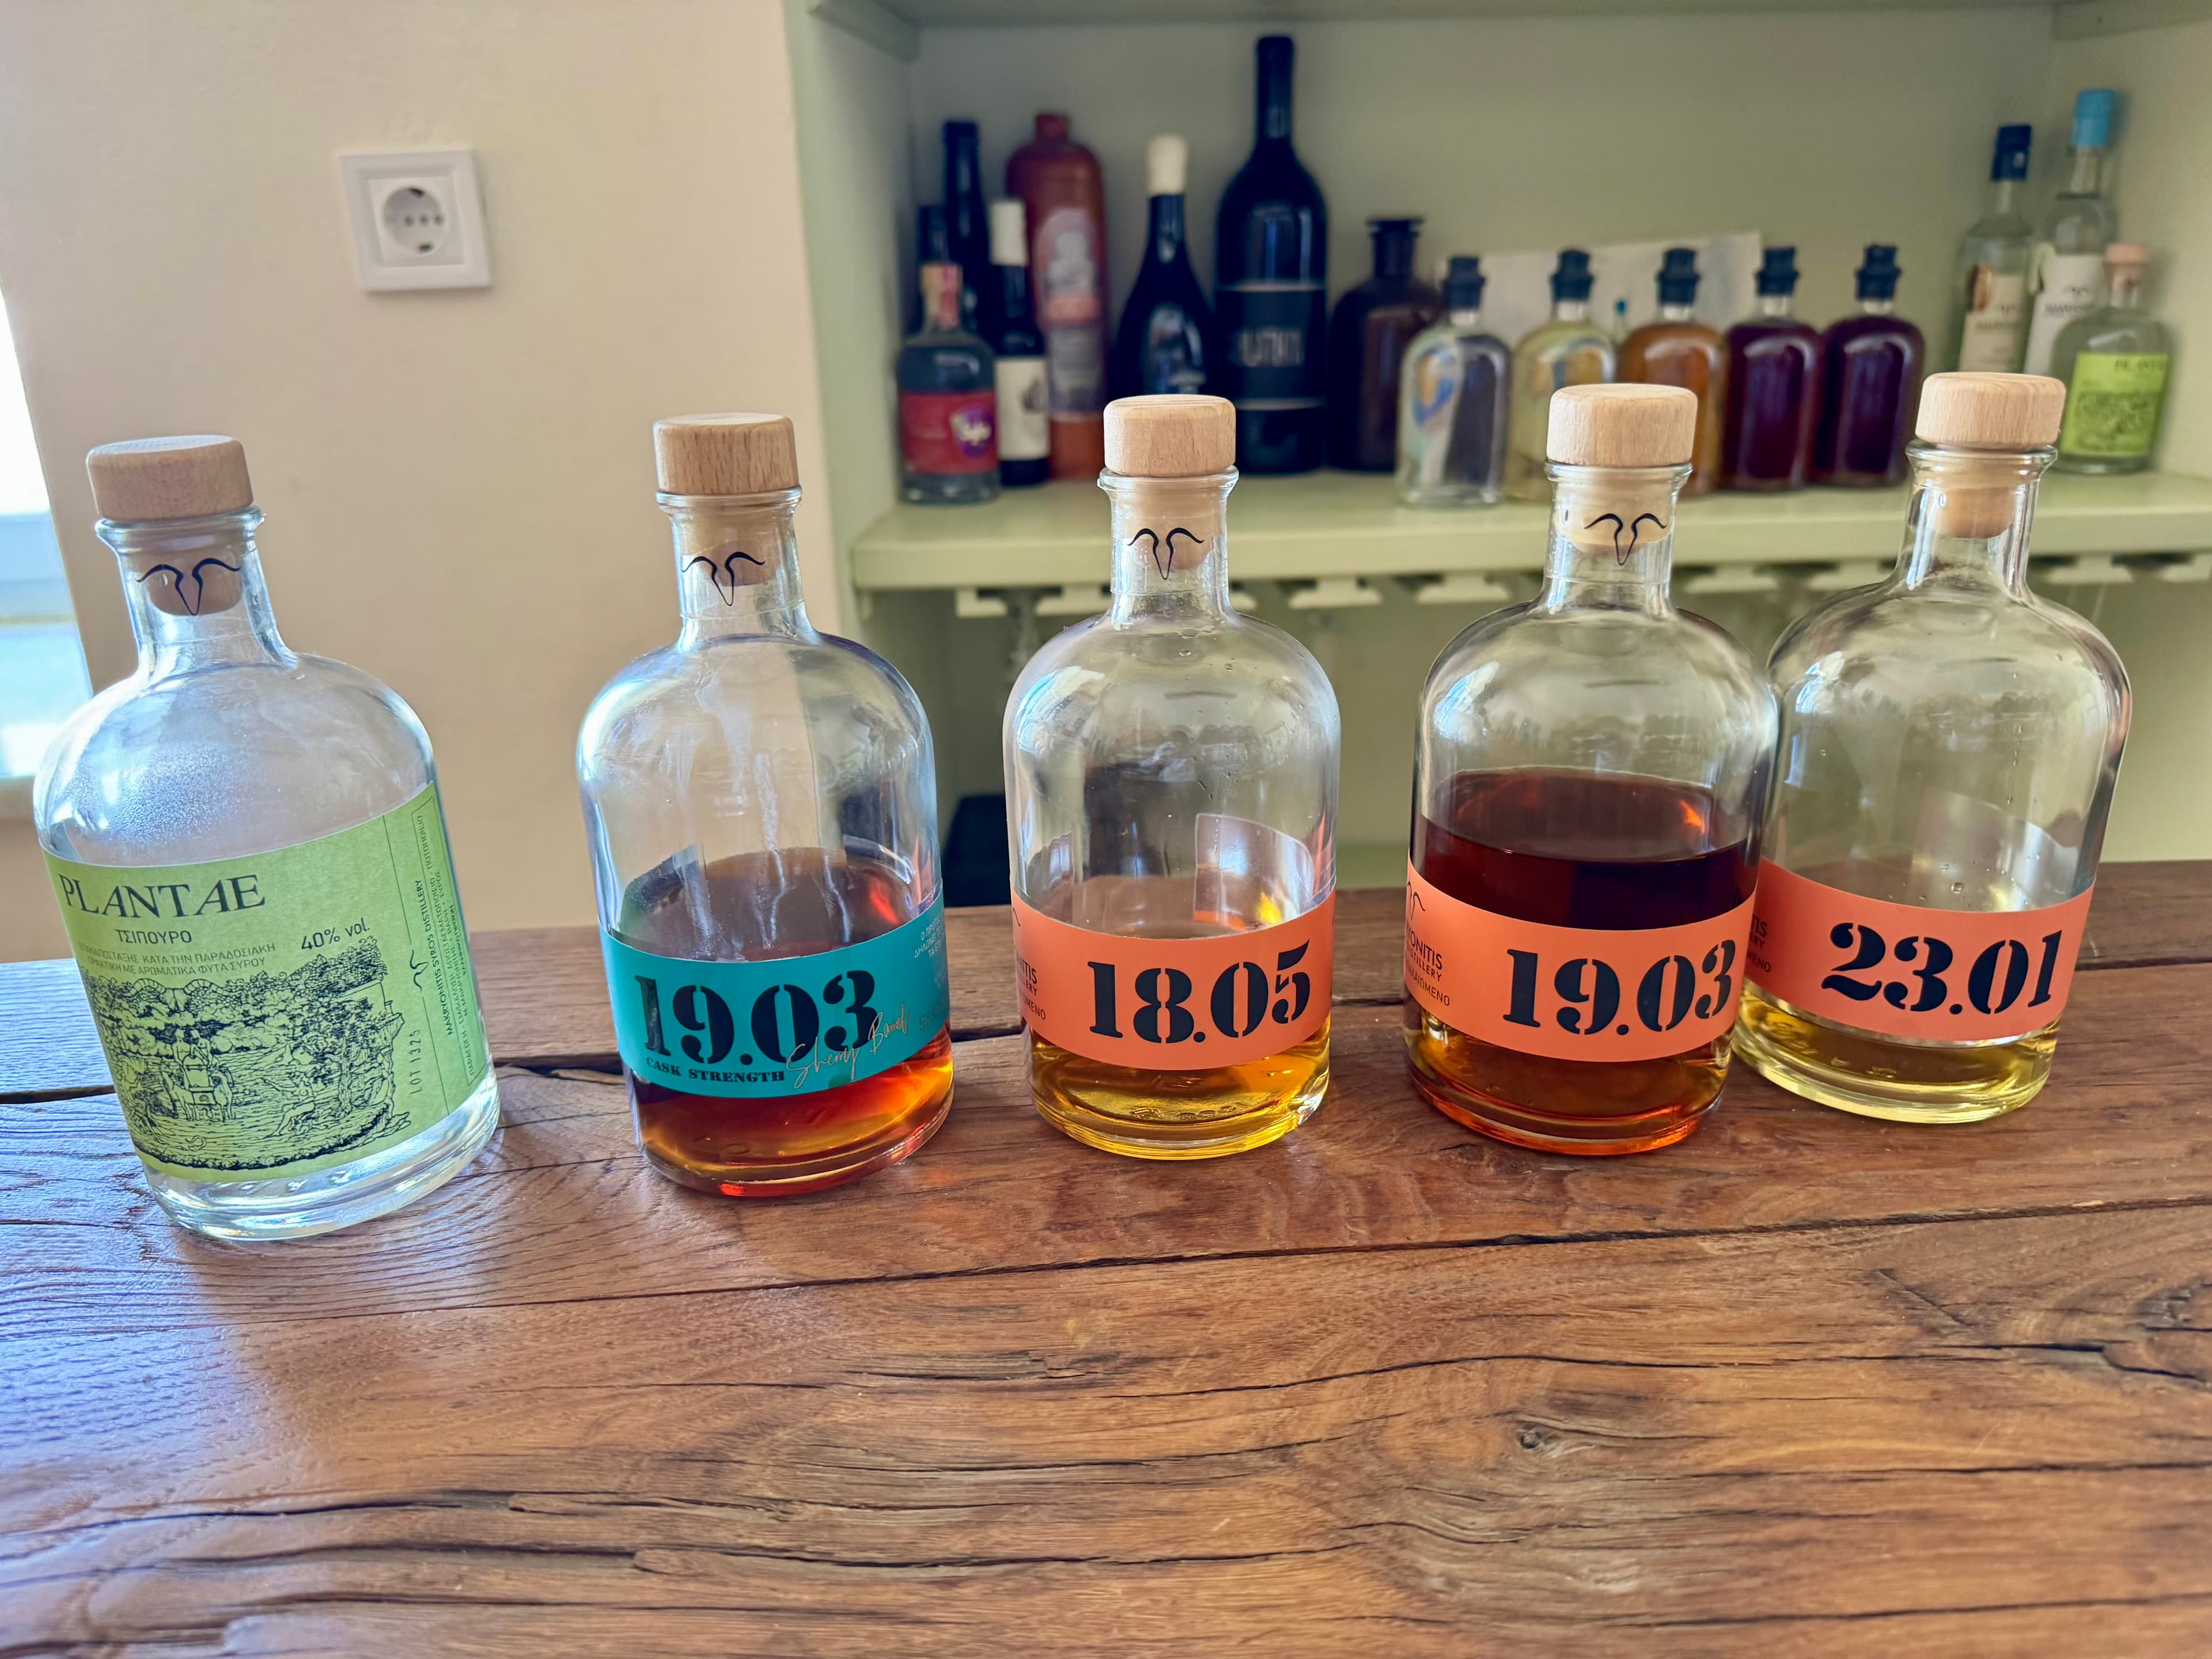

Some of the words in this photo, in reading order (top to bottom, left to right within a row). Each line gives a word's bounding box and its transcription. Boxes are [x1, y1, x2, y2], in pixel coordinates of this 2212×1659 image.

[58, 873, 266, 918] PLANTAE
[415, 880, 432, 932] DISTILLERY
[115, 929, 192, 945] ΤΣΙΠΟΥΡΟ
[301, 927, 340, 949] 40%
[344, 917, 370, 937] vol.
[427, 934, 440, 968] SYROS
[123, 965, 137, 974] ΜΕ
[138, 965, 196, 976] ΑΡΩΜΑΤΙΚΑ
[198, 963, 229, 974] ΦΥΤΑ
[230, 957, 266, 971] ΣΥΡΟΥ
[143, 955, 169, 964] ΚΑΤΑ
[171, 954, 192, 964] ΤΗΝ
[195, 943, 276, 963] ΠΑΡΑΔΟΣΙΑΚΗ
[1821, 922, 2063, 1015] 23.01
[434, 968, 453, 1035] MAKRYONITIS
[1087, 939, 1310, 1044] 18.05
[1502, 940, 1736, 1036] 19.03
[635, 969, 880, 1065] 19.03
[409, 1029, 421, 1063] 1325
[786, 1036, 861, 1089] Sherry
[868, 1003, 910, 1054] Barrel
[409, 1070, 422, 1094] LOT
[646, 1056, 681, 1076] CASK
[688, 1068, 785, 1083] STRENGTH
